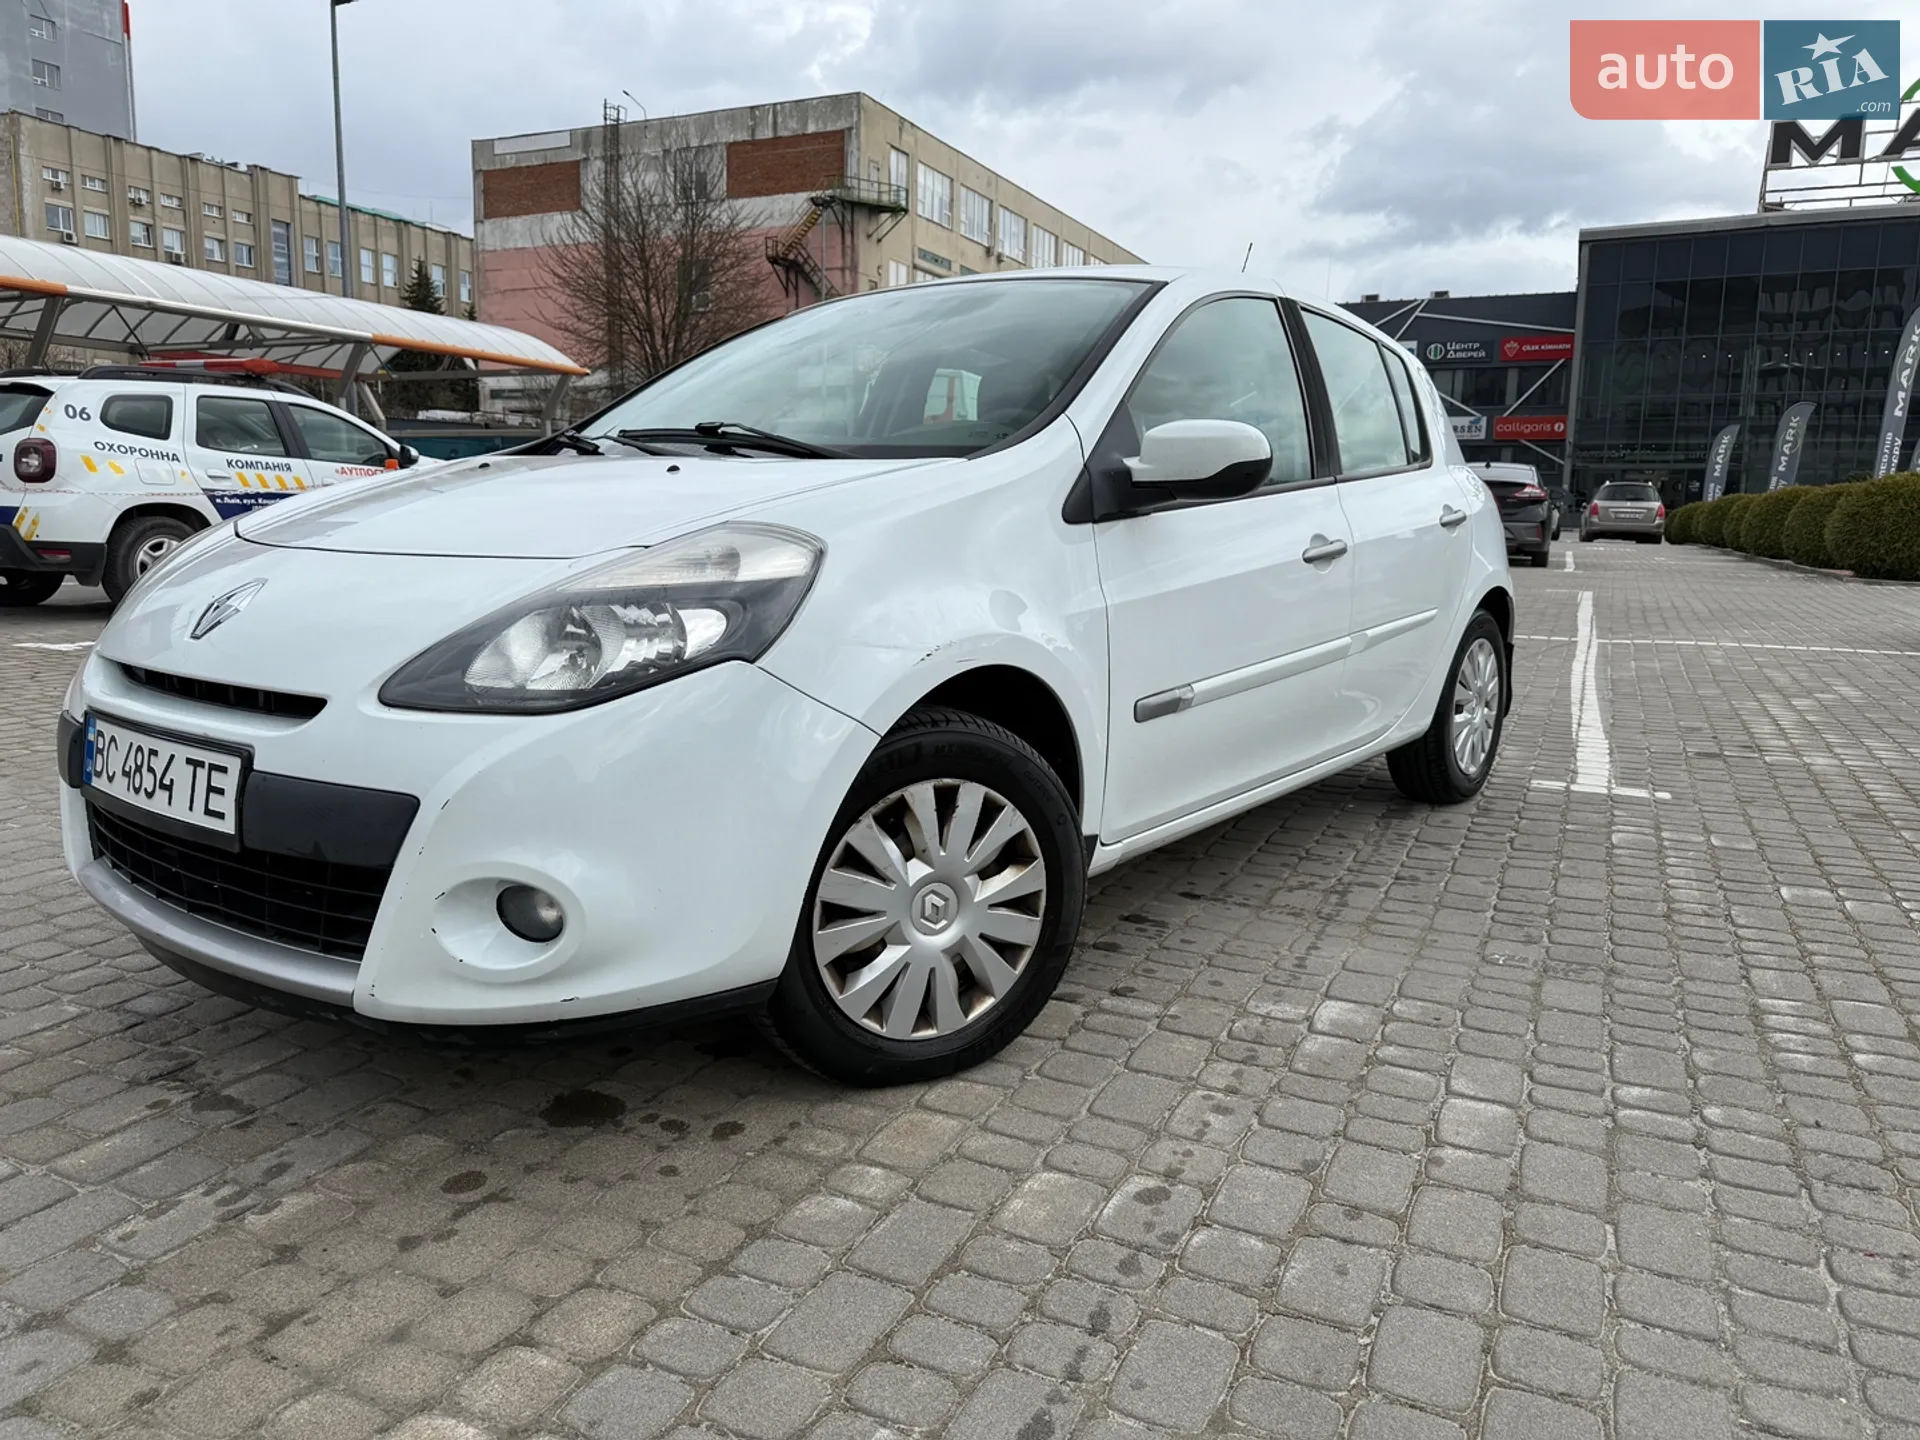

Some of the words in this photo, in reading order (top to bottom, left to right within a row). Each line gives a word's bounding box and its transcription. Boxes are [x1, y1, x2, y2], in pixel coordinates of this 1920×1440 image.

[64, 404, 92, 421] 06
[1496, 422, 1552, 434] calligaris
[93, 441, 181, 463] ОХОРОННА
[1778, 416, 1800, 472] MARK
[226, 458, 292, 472] КОМПАНІЯ
[1713, 434, 1731, 477] MARK
[94, 729, 119, 783] BC
[121, 741, 176, 806] 4854
[185, 756, 229, 820] TE
